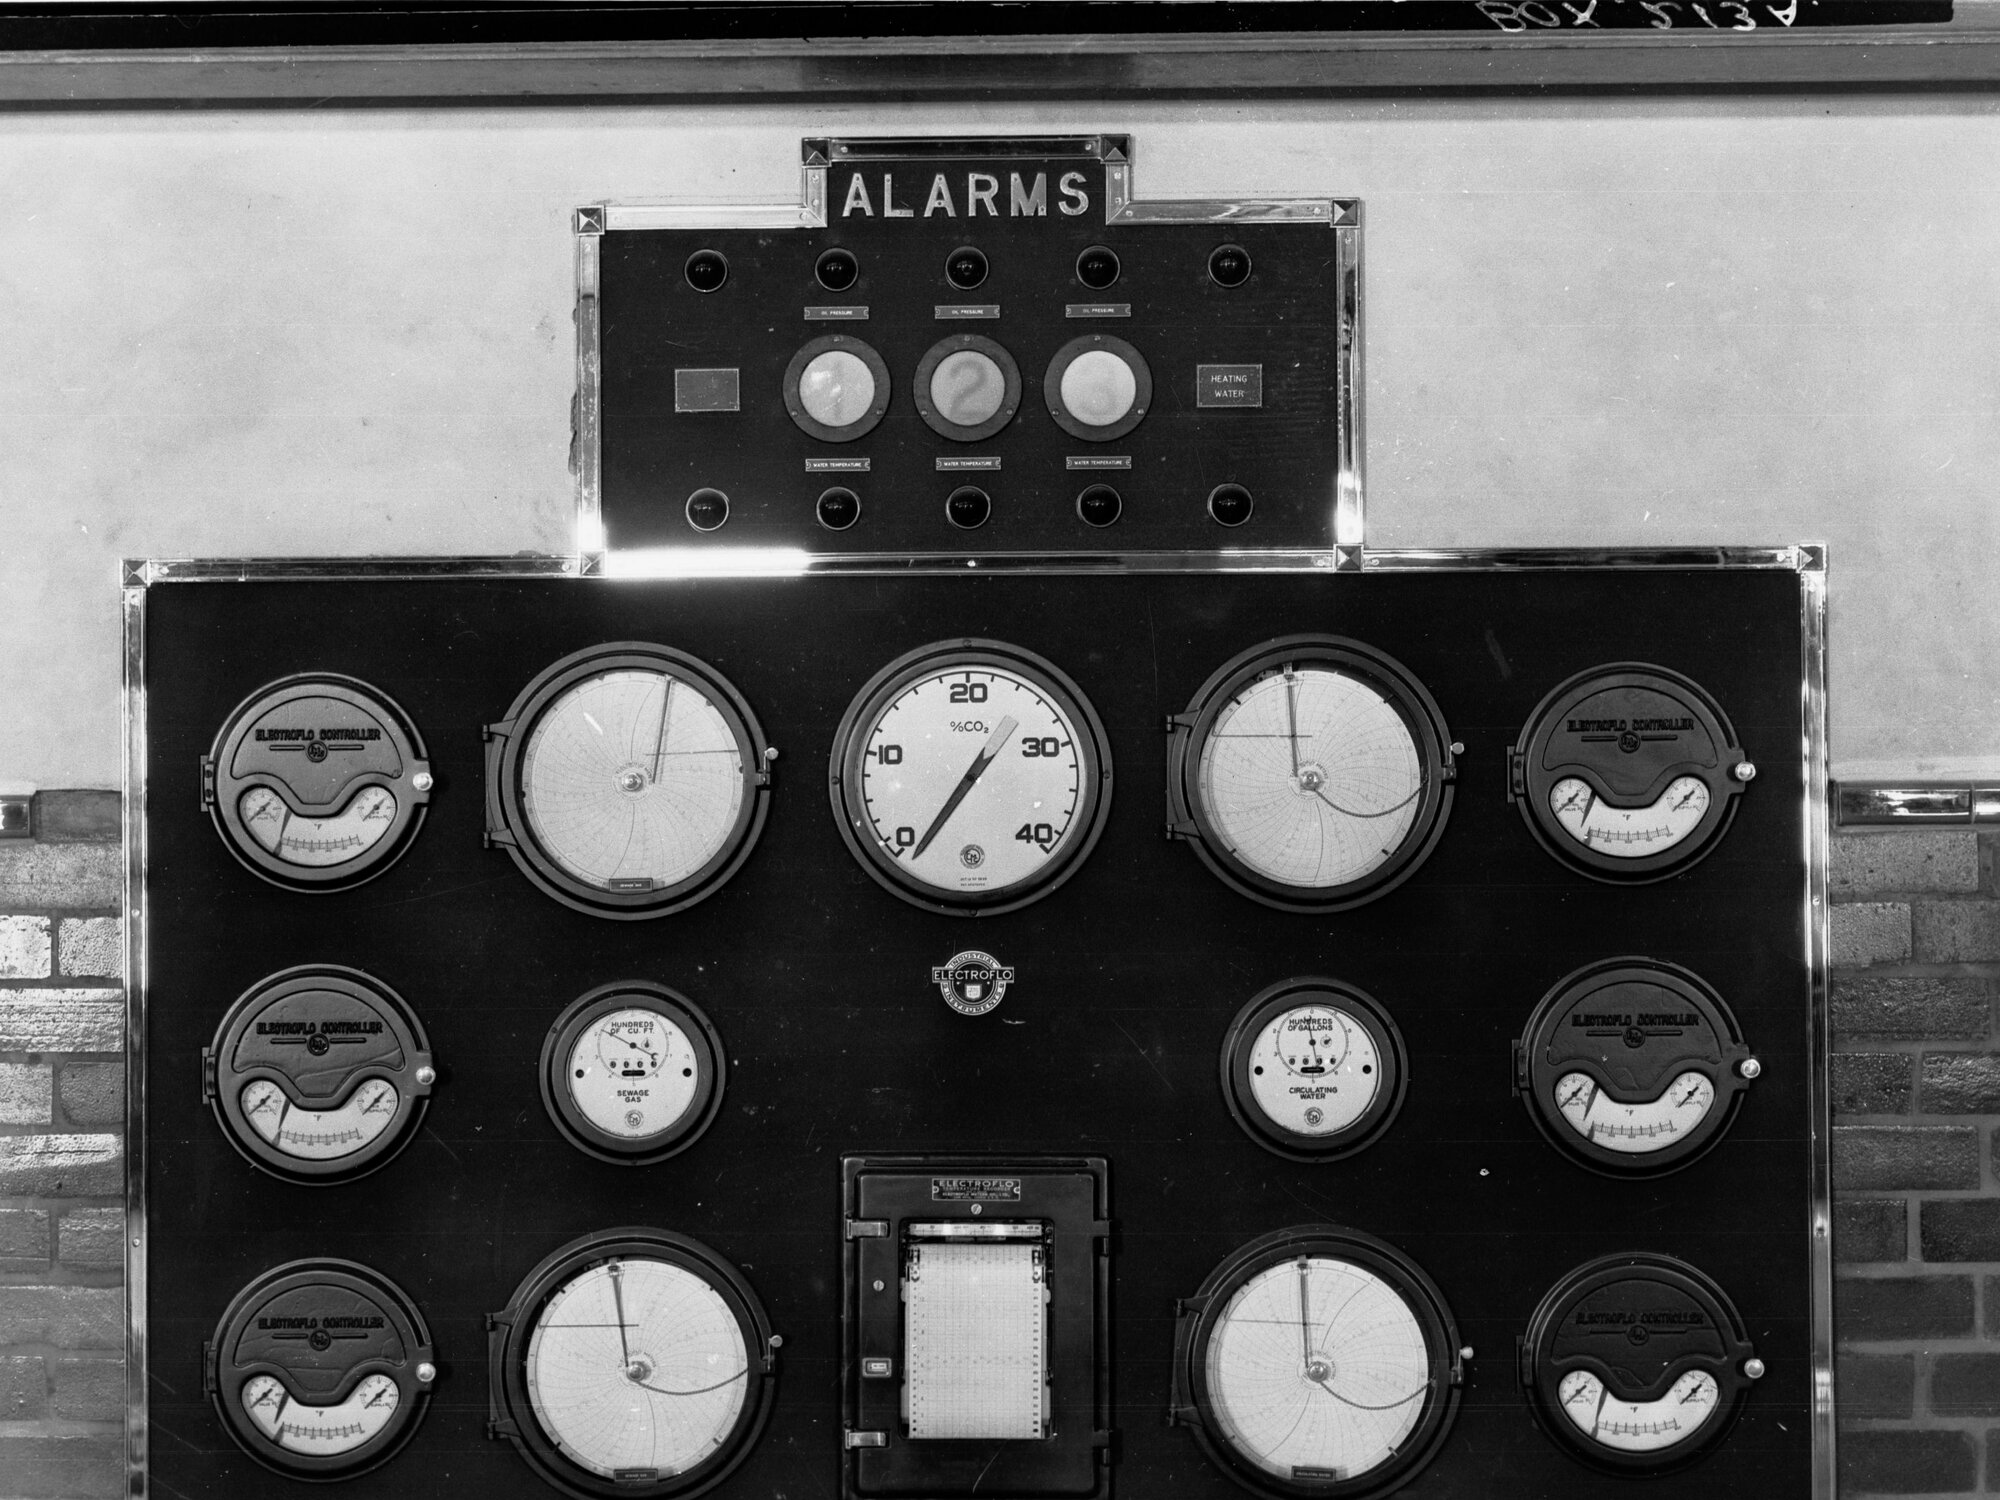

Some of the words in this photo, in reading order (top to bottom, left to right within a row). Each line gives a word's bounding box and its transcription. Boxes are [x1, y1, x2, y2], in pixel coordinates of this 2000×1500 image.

[842, 172, 1089, 217] ALARMS
[951, 359, 988, 417] 2
[1211, 375, 1248, 383] HEATING
[1214, 390, 1244, 398] WATER
[950, 683, 988, 703] 20
[879, 745, 902, 765] 10
[1022, 737, 1060, 757] 30
[896, 826, 915, 846] 0
[1015, 823, 1053, 843] 40
[934, 970, 1012, 980] ELECTROFLO
